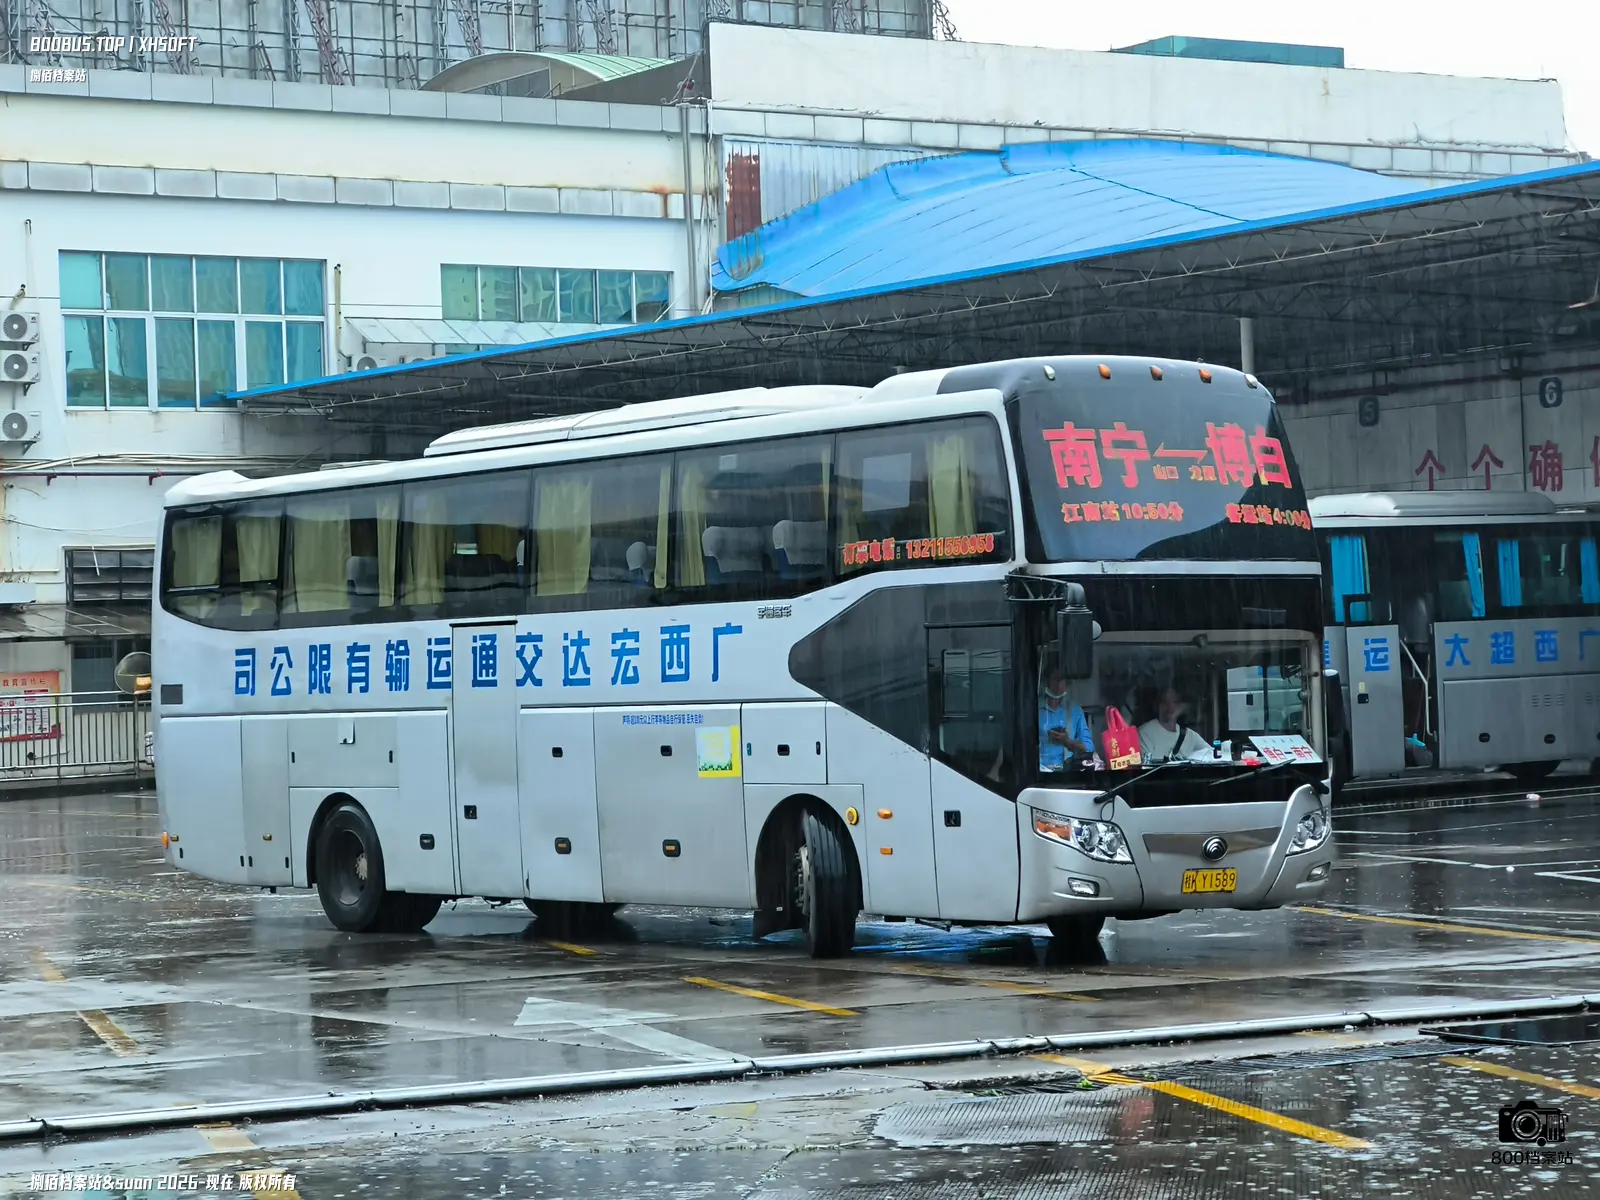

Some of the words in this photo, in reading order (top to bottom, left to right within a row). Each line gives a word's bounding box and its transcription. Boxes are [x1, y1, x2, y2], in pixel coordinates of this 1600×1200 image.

[1042, 421, 1150, 488] 南宁
[1205, 422, 1292, 489] 博白
[234, 622, 743, 697] 广西宏达交通运输有限公司
[1324, 629, 1600, 672] 广西超大运
